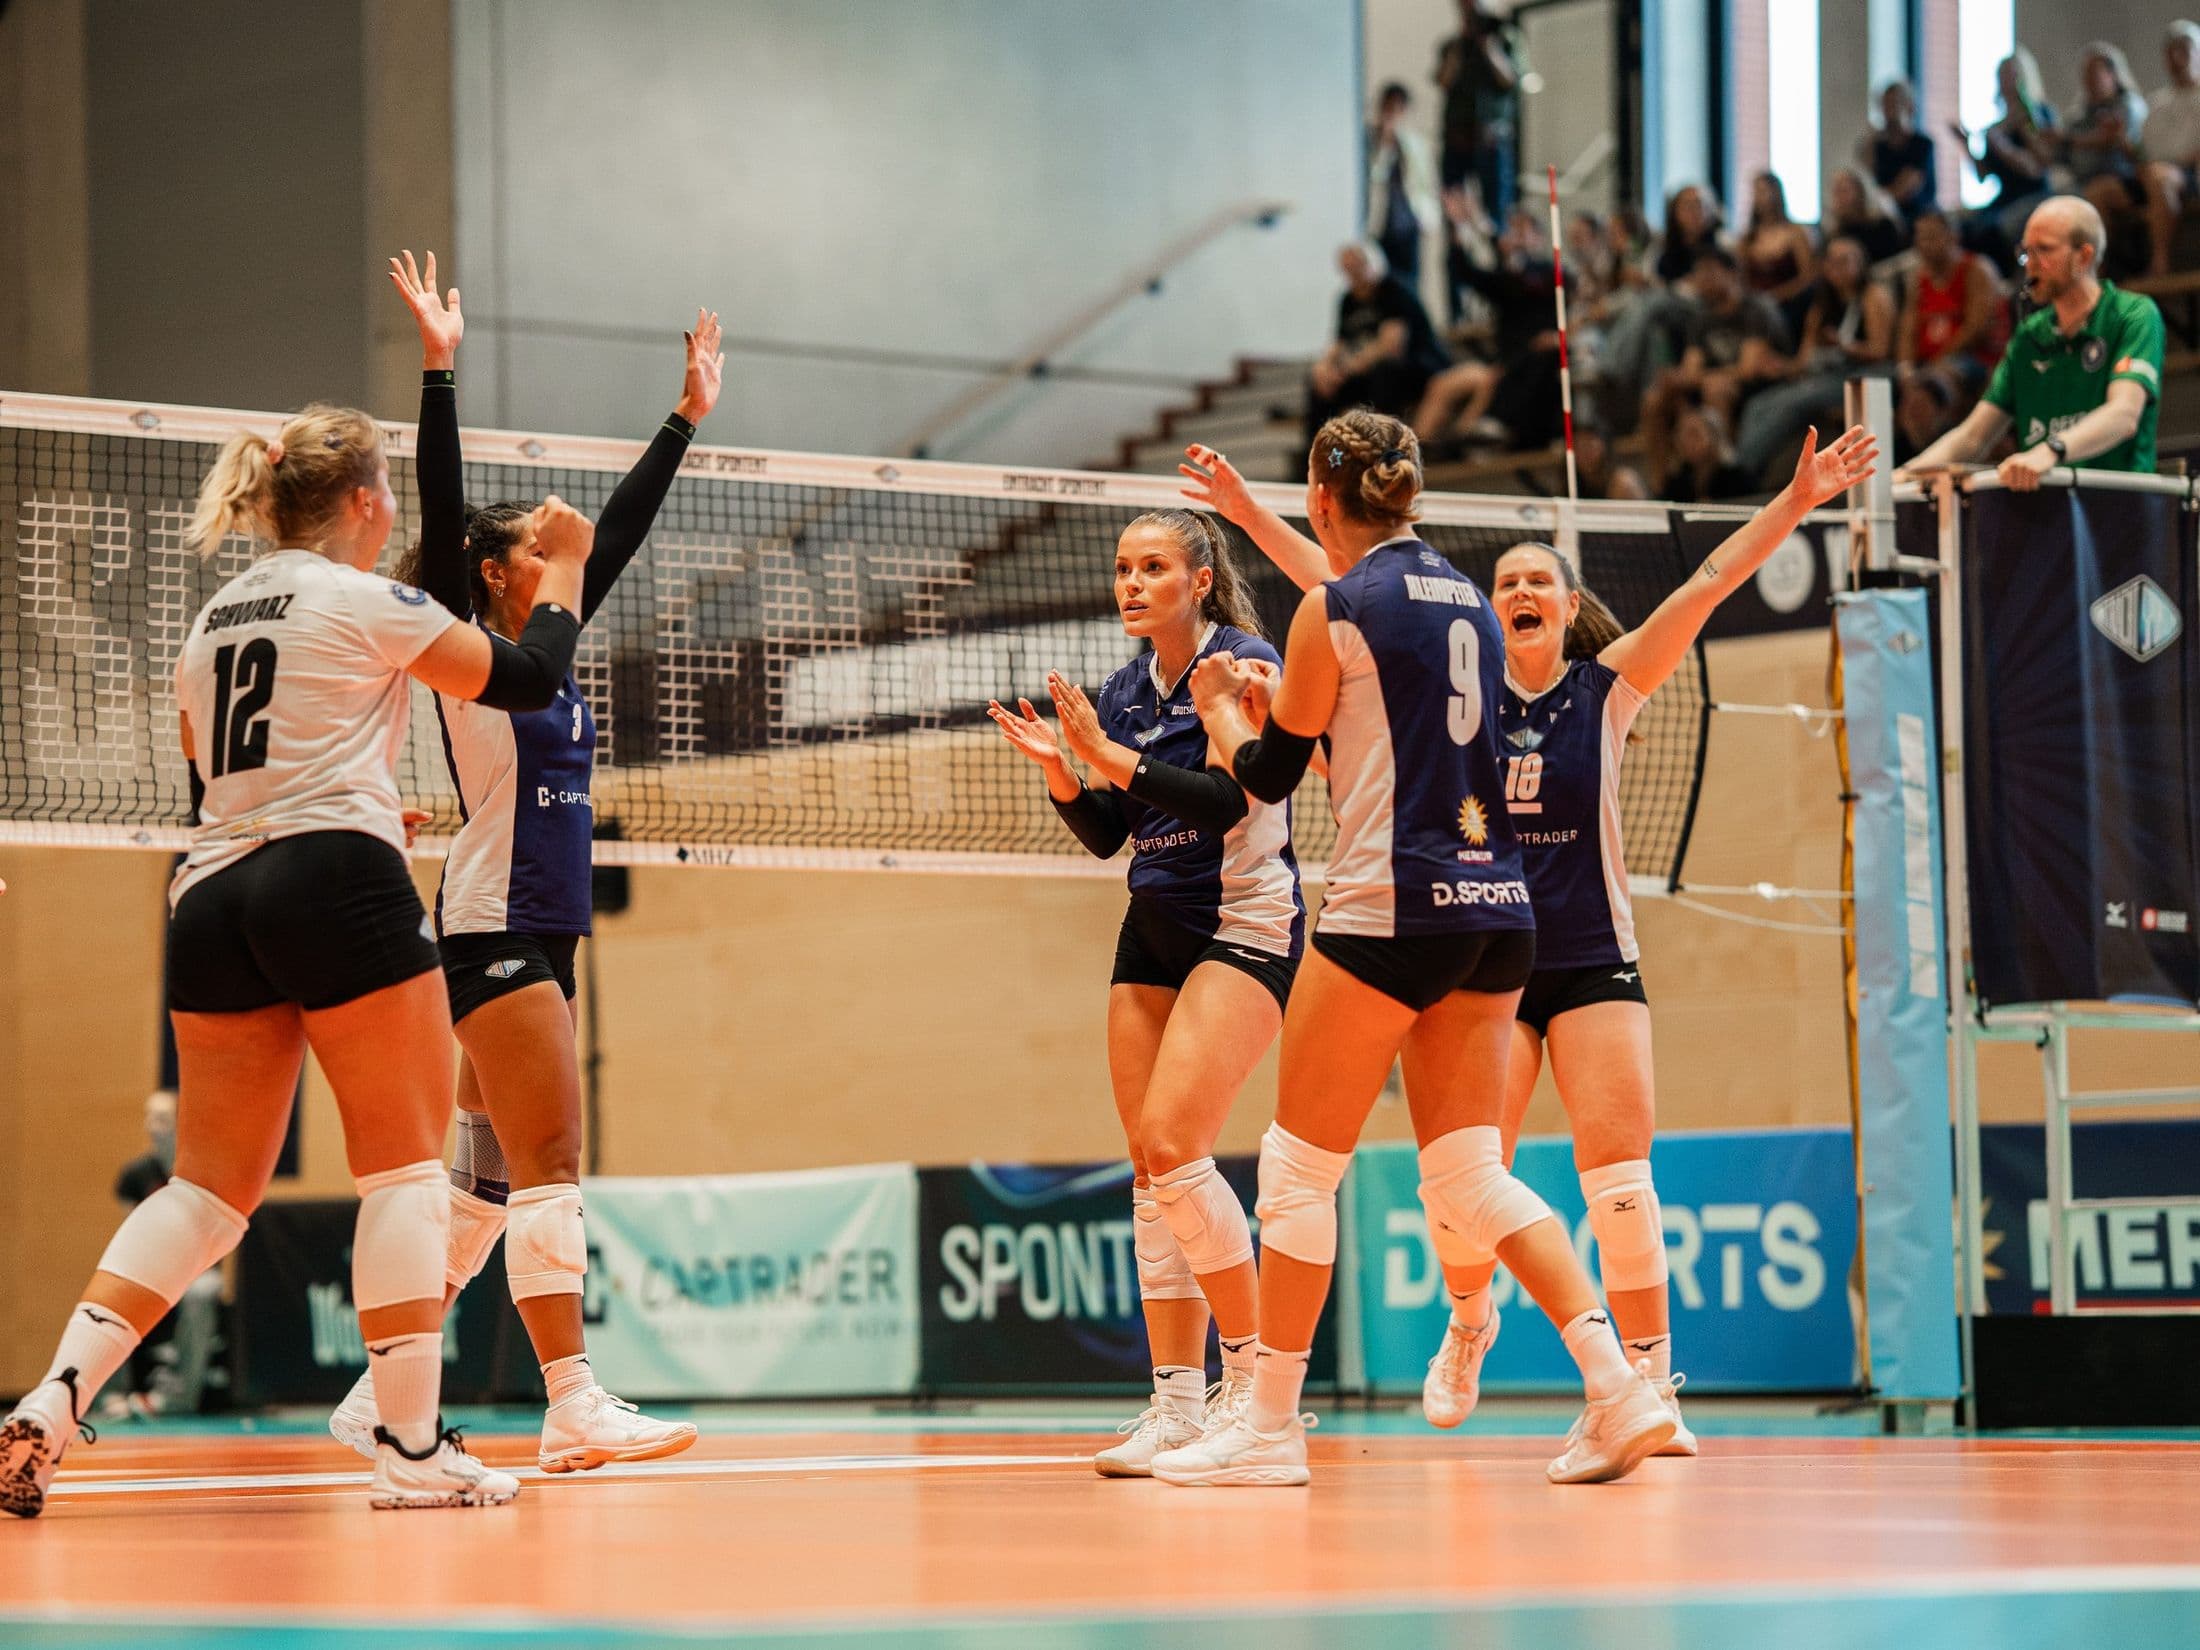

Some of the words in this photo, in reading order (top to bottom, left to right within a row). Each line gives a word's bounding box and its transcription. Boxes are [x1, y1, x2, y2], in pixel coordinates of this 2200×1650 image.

[204, 593, 295, 635] SCHWARZ
[1446, 618, 1482, 746] 9
[211, 637, 278, 779] 12
[571, 703, 583, 742] 3
[1504, 752, 1543, 801] 18
